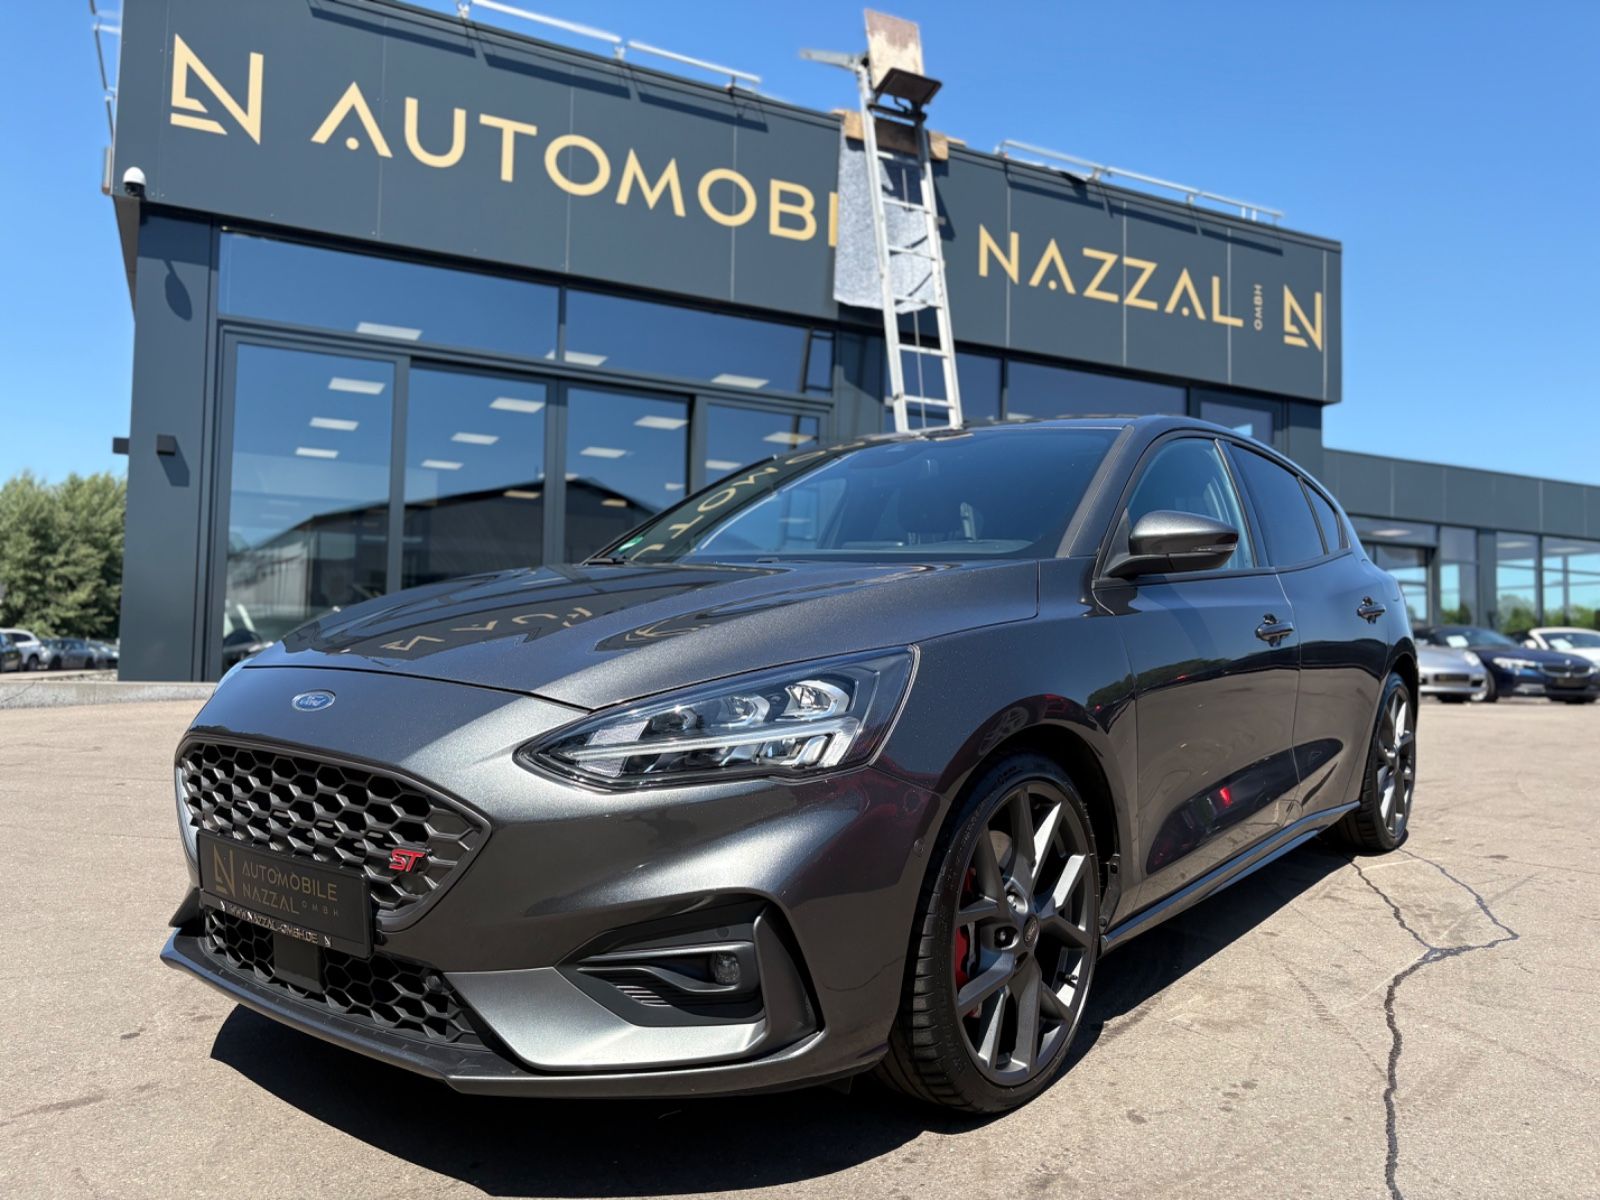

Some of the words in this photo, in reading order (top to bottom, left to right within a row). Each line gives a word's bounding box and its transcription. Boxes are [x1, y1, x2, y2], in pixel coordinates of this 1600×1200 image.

[311, 81, 838, 247] AUTOMOBI
[978, 225, 1244, 328] NAZZAL
[389, 848, 426, 872] ST
[241, 861, 338, 902] AUTOMOBILE
[242, 882, 300, 915] NAZZAL
